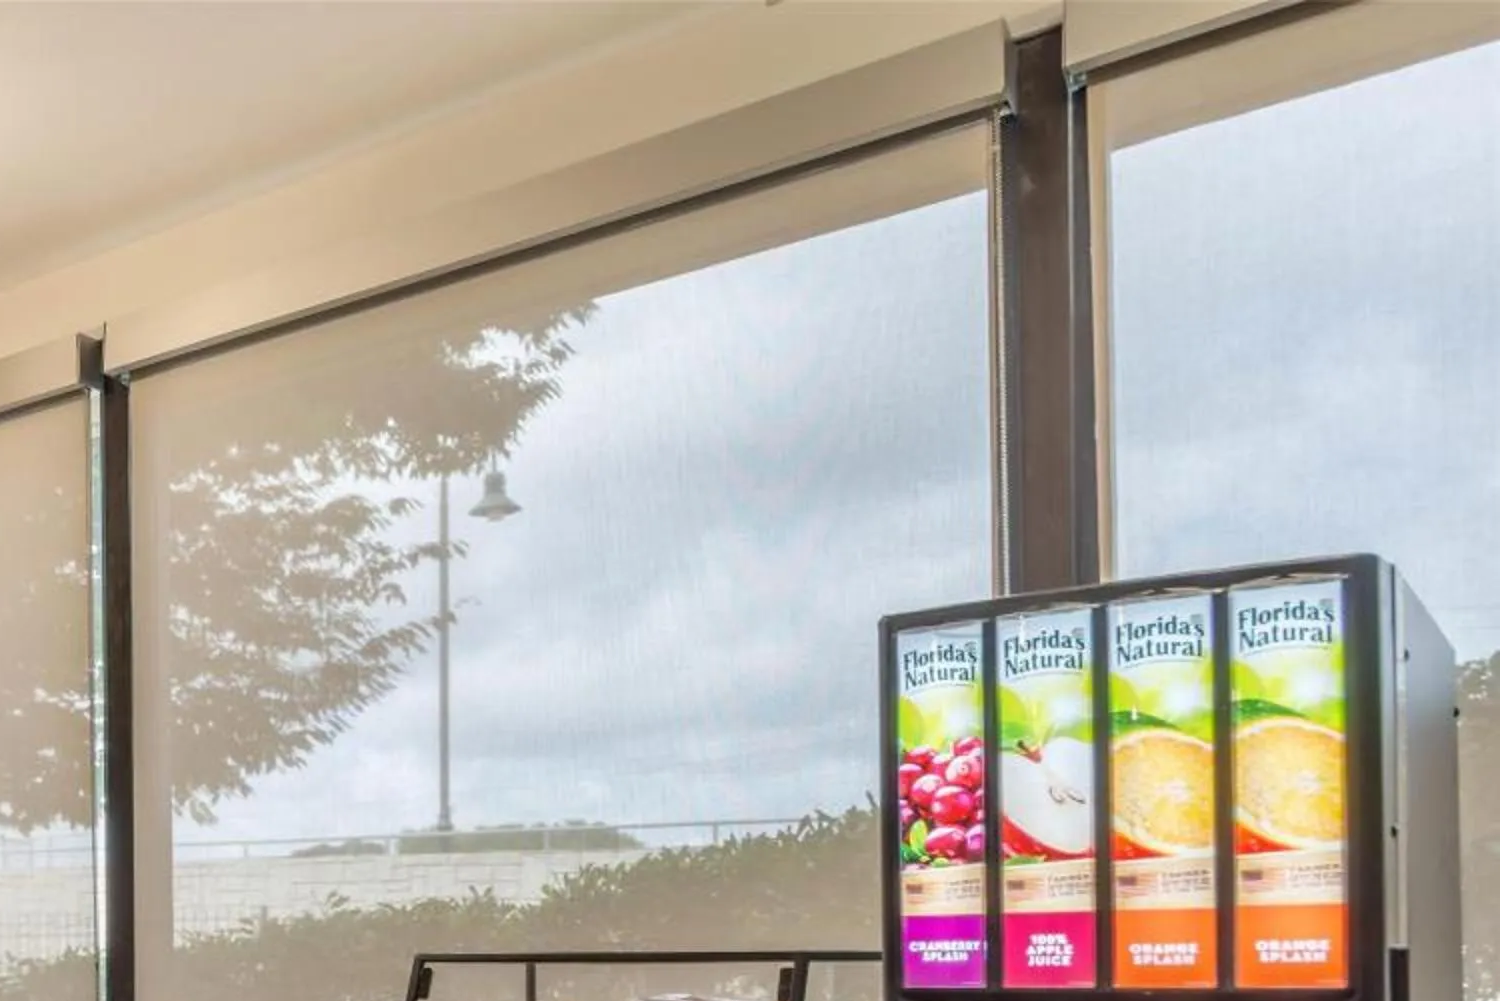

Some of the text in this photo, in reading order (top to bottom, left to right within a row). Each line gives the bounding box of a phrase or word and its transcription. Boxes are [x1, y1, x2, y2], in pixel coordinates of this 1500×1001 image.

[1238, 599, 1334, 630] Florida's
[1116, 614, 1205, 644] Florida's
[1239, 625, 1333, 649] Natural
[1117, 639, 1203, 666] Natural
[1005, 652, 1084, 678] Natural
[905, 666, 976, 691] Natural
[1029, 934, 1068, 945] 100%
[1255, 939, 1331, 951] ORANGE
[908, 940, 981, 952] CRANBERRY
[1026, 945, 1074, 956] APPLE
[1128, 942, 1198, 954] ORANGE
[922, 951, 969, 962] SPLASH
[1028, 955, 1072, 967] JUICE
[1132, 953, 1196, 965] SPLASH
[1259, 951, 1328, 963] SPLASH
